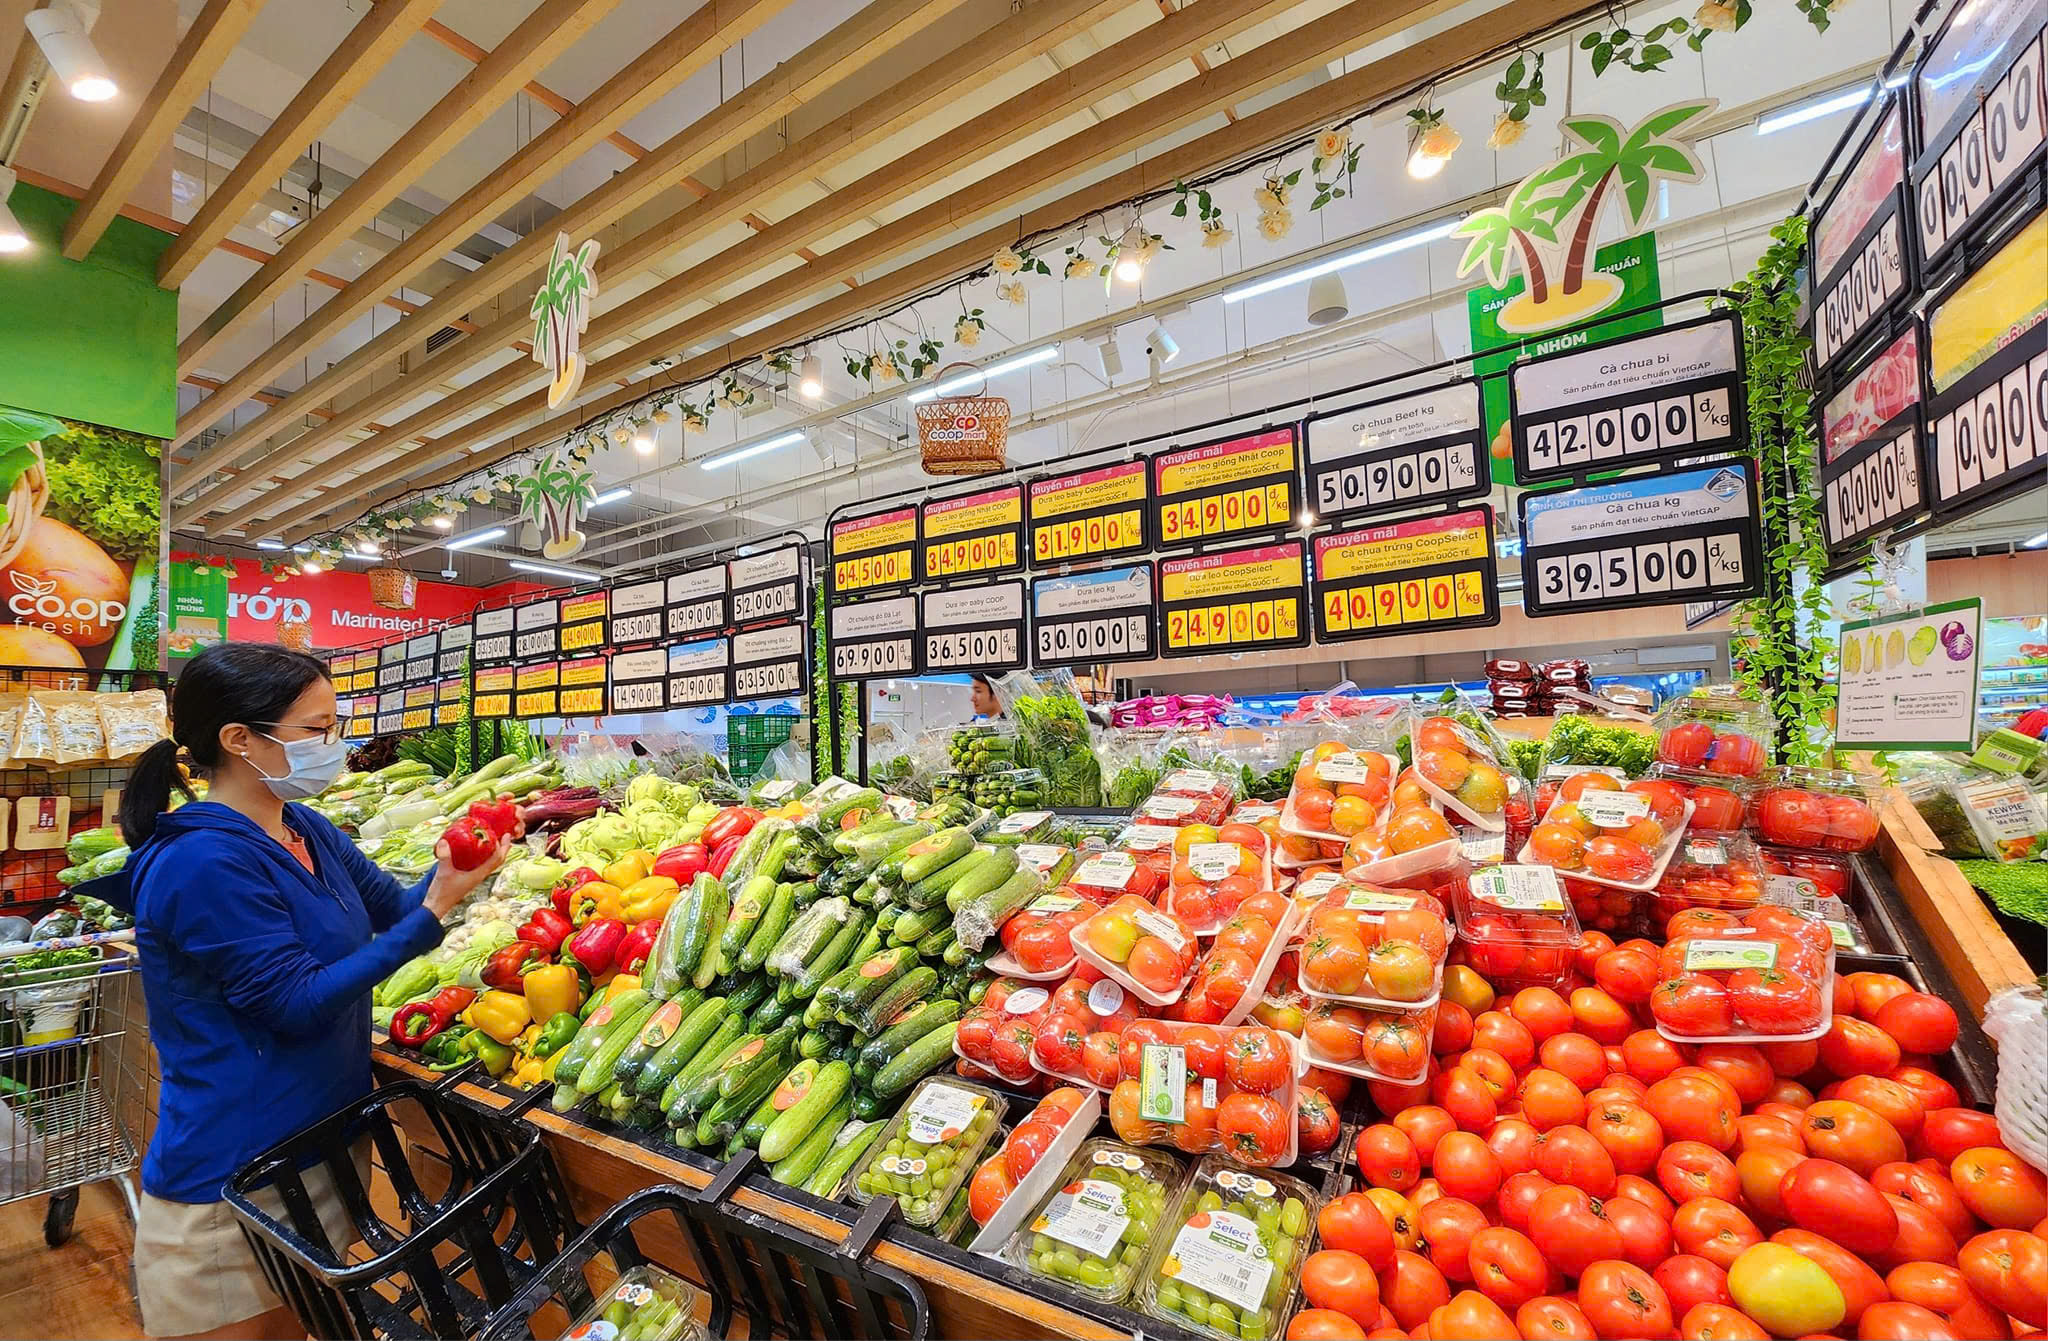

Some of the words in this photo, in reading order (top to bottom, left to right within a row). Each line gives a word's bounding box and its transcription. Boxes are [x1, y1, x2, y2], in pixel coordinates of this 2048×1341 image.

[1828, 249, 1878, 344] 0.000
[1536, 331, 1588, 356] NHÓM
[1600, 362, 1617, 375] Cà
[1620, 358, 1653, 371] chua
[1657, 354, 1670, 364] bi
[1642, 369, 1670, 382] chuẩn
[1672, 362, 1711, 374] VietGAP
[1352, 420, 1366, 432] Cà
[1368, 415, 1392, 428] chua
[1395, 408, 1419, 422] Beef
[1422, 405, 1434, 416] kg
[1534, 405, 1686, 458] 42.000
[1700, 398, 1729, 426] đ/kg
[1160, 451, 1200, 466] Khuyến
[1204, 446, 1222, 457] mãi
[1261, 448, 1284, 459] Coop
[1323, 456, 1440, 504] 50.900
[1450, 452, 1474, 476] đ/kg
[1842, 456, 1896, 526] 0.000
[1167, 494, 1260, 534] 34.900
[1270, 488, 1288, 510] đ/kg
[1606, 502, 1624, 514] Cà
[1628, 497, 1660, 511] chua
[1664, 496, 1680, 508] kg
[1651, 510, 1679, 522] chuẩn
[1682, 506, 1720, 518] VietGAP
[1040, 520, 1118, 554] 31.900
[1320, 532, 1370, 548] Khuyến
[1374, 526, 1398, 538] mãi
[1341, 548, 1354, 560] Cà
[1357, 544, 1381, 556] chua
[1384, 540, 1412, 554] trứng
[1416, 531, 1478, 548] CoopSelect
[928, 540, 996, 571] 34.900
[1436, 550, 1458, 560] QUỐC
[838, 558, 894, 585] 64.500
[1224, 564, 1272, 577] CoopSelect
[1545, 548, 1697, 595] 39.500
[1710, 543, 1740, 572] đ/kg
[1107, 585, 1116, 593] kg
[1329, 582, 1450, 621] 40.900
[1456, 579, 1480, 604] đ/kg
[8, 593, 126, 627] co.op
[736, 590, 782, 614] 52.000
[13, 616, 92, 635] fresh
[332, 610, 422, 632] Marinated
[614, 618, 651, 638] 25.500
[670, 606, 711, 628] 29.900
[1172, 610, 1270, 640] 24.900
[1277, 605, 1296, 630] đ/kg
[1041, 622, 1122, 652] 30.000
[1130, 621, 1146, 642] đ/kg
[836, 645, 894, 668] 69.900
[930, 636, 998, 660] 36.500
[672, 678, 713, 698] 22.900
[738, 668, 784, 690] 63.500
[616, 688, 652, 704] 14.900
[1085, 1187, 1116, 1203] Select
[1214, 1220, 1252, 1242] Select
